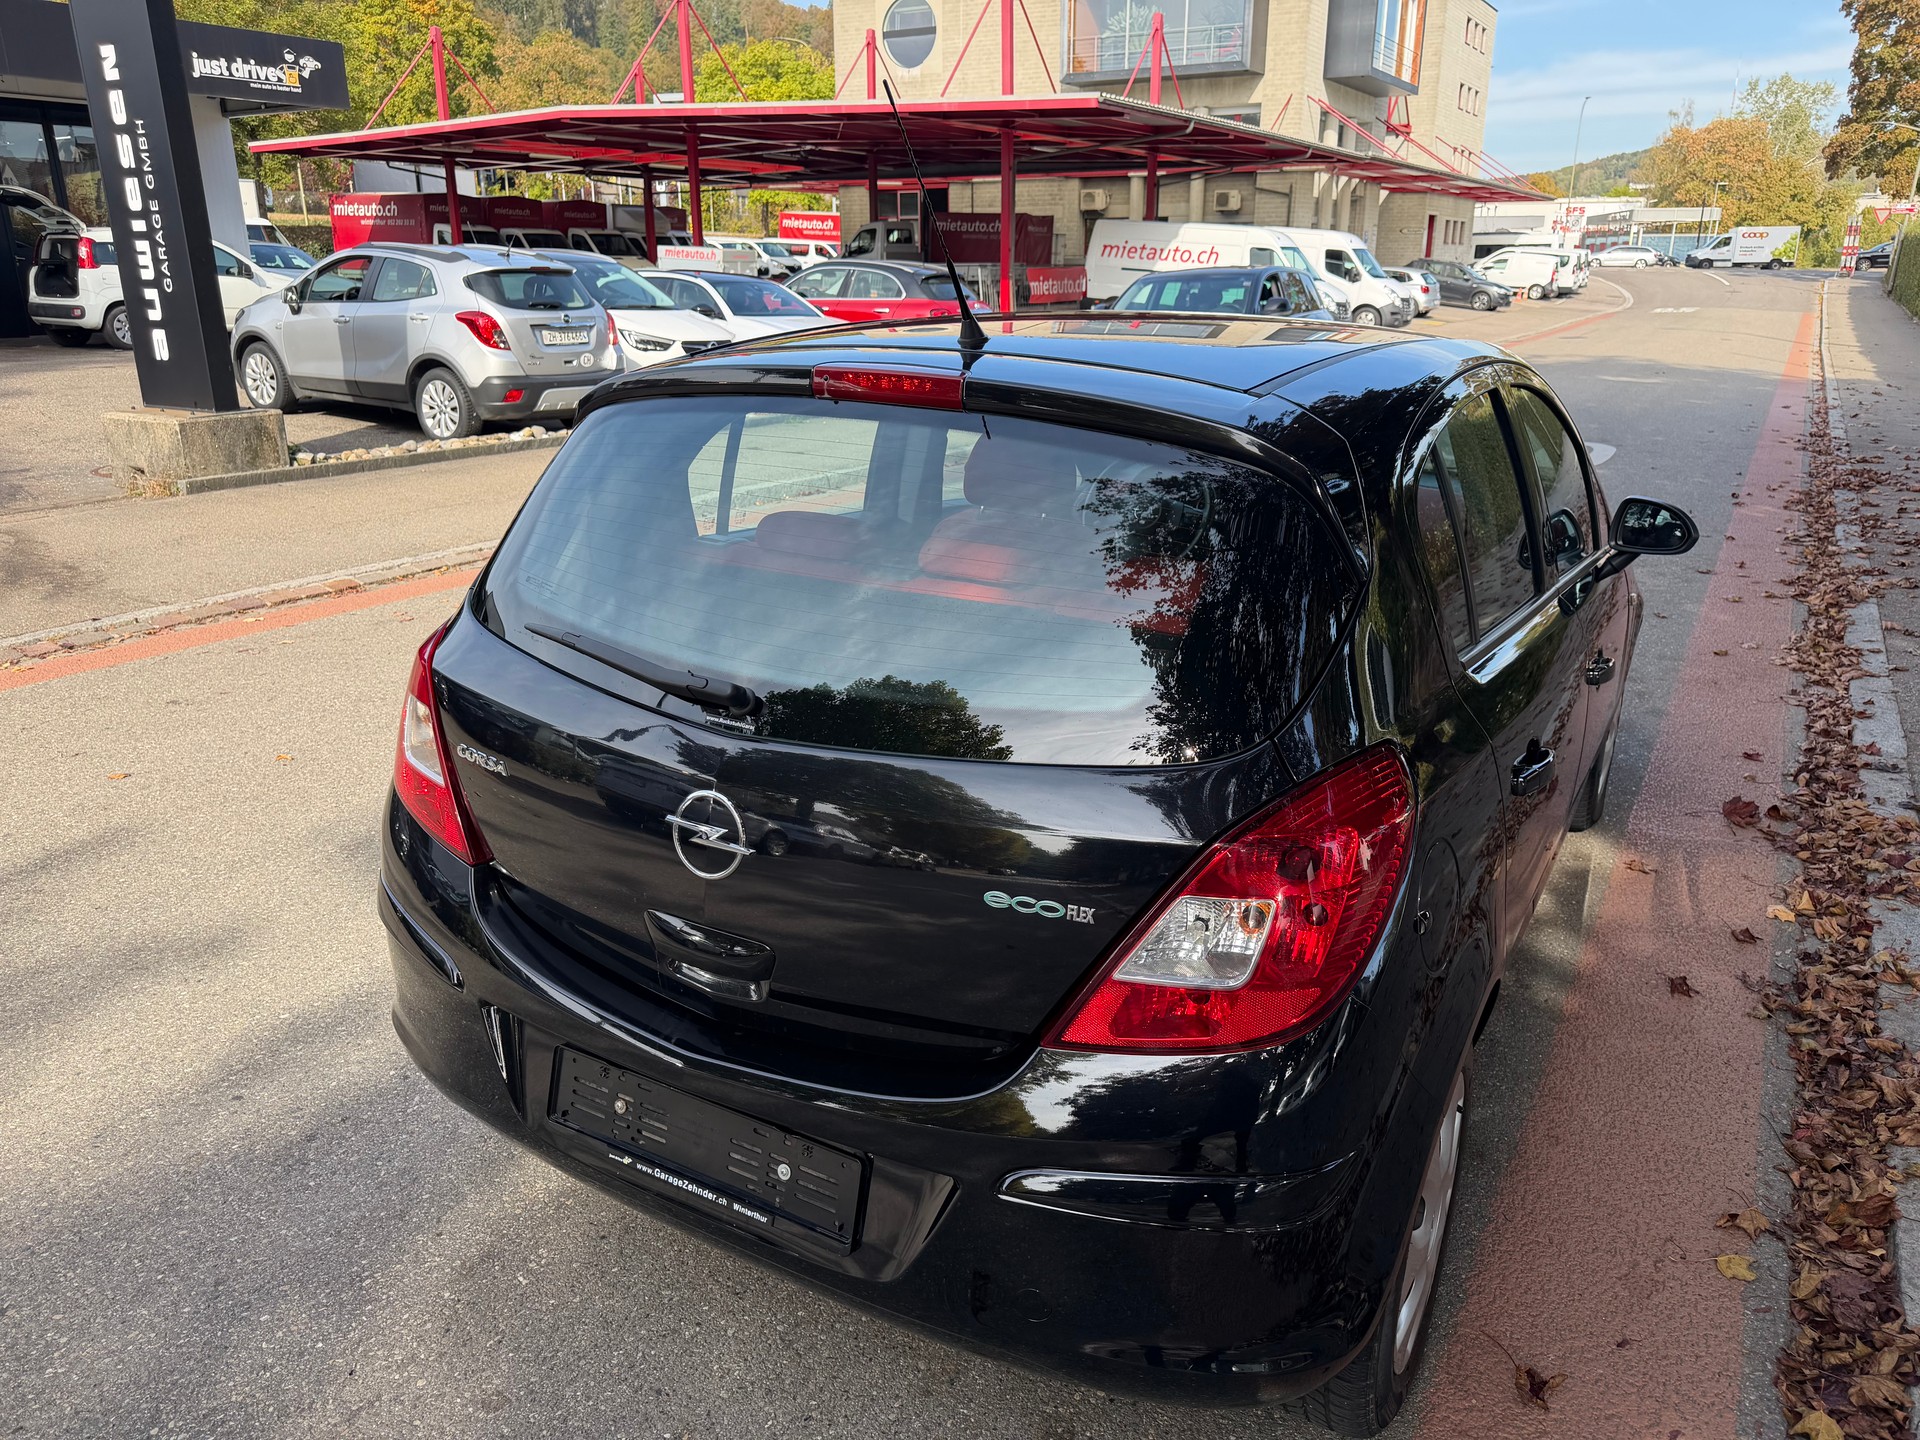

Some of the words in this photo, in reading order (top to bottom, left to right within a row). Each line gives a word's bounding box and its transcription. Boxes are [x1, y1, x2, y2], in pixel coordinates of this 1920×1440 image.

[191, 51, 229, 78] just
[231, 57, 278, 82] drive
[134, 119, 156, 190] GMBH
[333, 200, 398, 217] mietauto.ch
[1566, 206, 1586, 215] SFS
[782, 216, 834, 230] mietauto.ch
[149, 199, 173, 293] GARAGE
[1742, 231, 1769, 240] coop
[664, 246, 717, 262] mietauto.ch
[1101, 240, 1219, 265] mietauto.ch
[1030, 275, 1086, 296] mietauto.ch
[583, 355, 592, 365] CH
[456, 743, 510, 777] CORSA
[636, 1162, 728, 1207] www.GarageZehnder.ch
[733, 1202, 768, 1224] Winterthur
